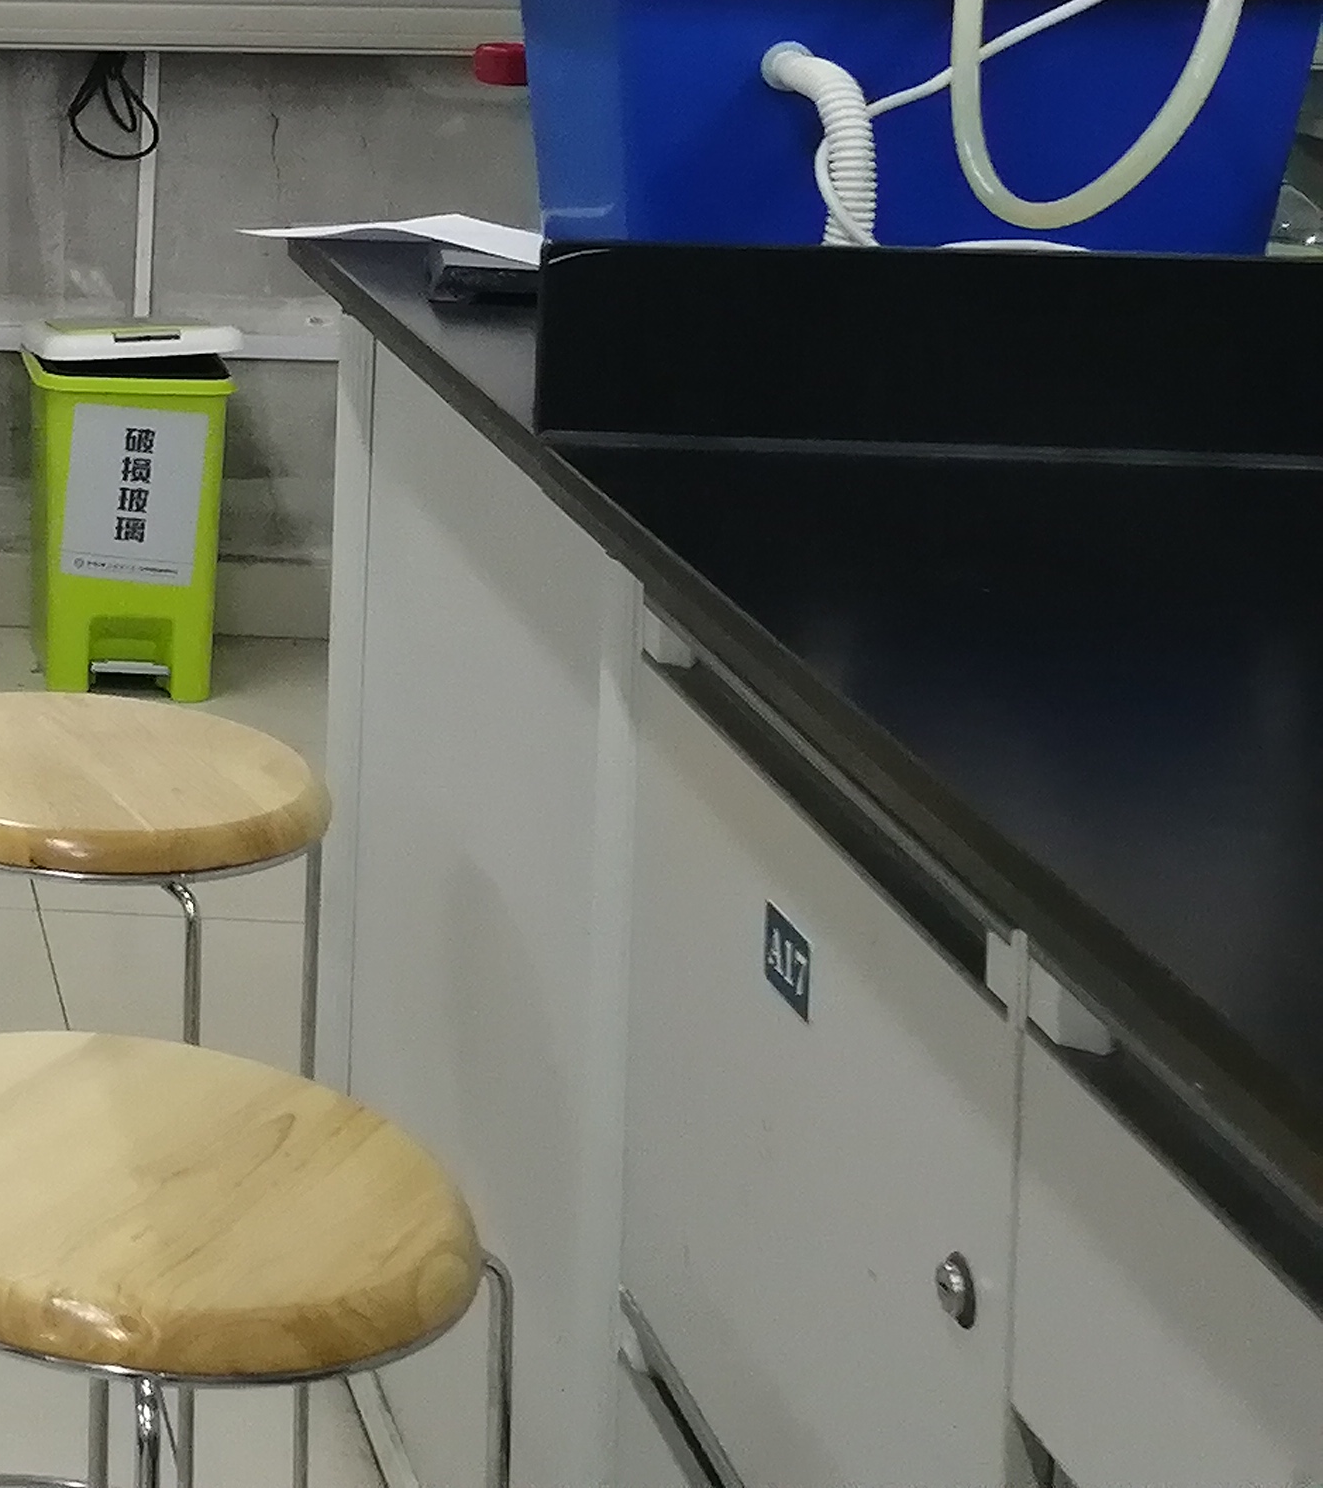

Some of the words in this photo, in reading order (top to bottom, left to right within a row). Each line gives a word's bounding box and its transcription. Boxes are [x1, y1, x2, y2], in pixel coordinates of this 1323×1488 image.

[113, 426, 157, 545] 破损玻璃
[766, 927, 808, 996] A17
